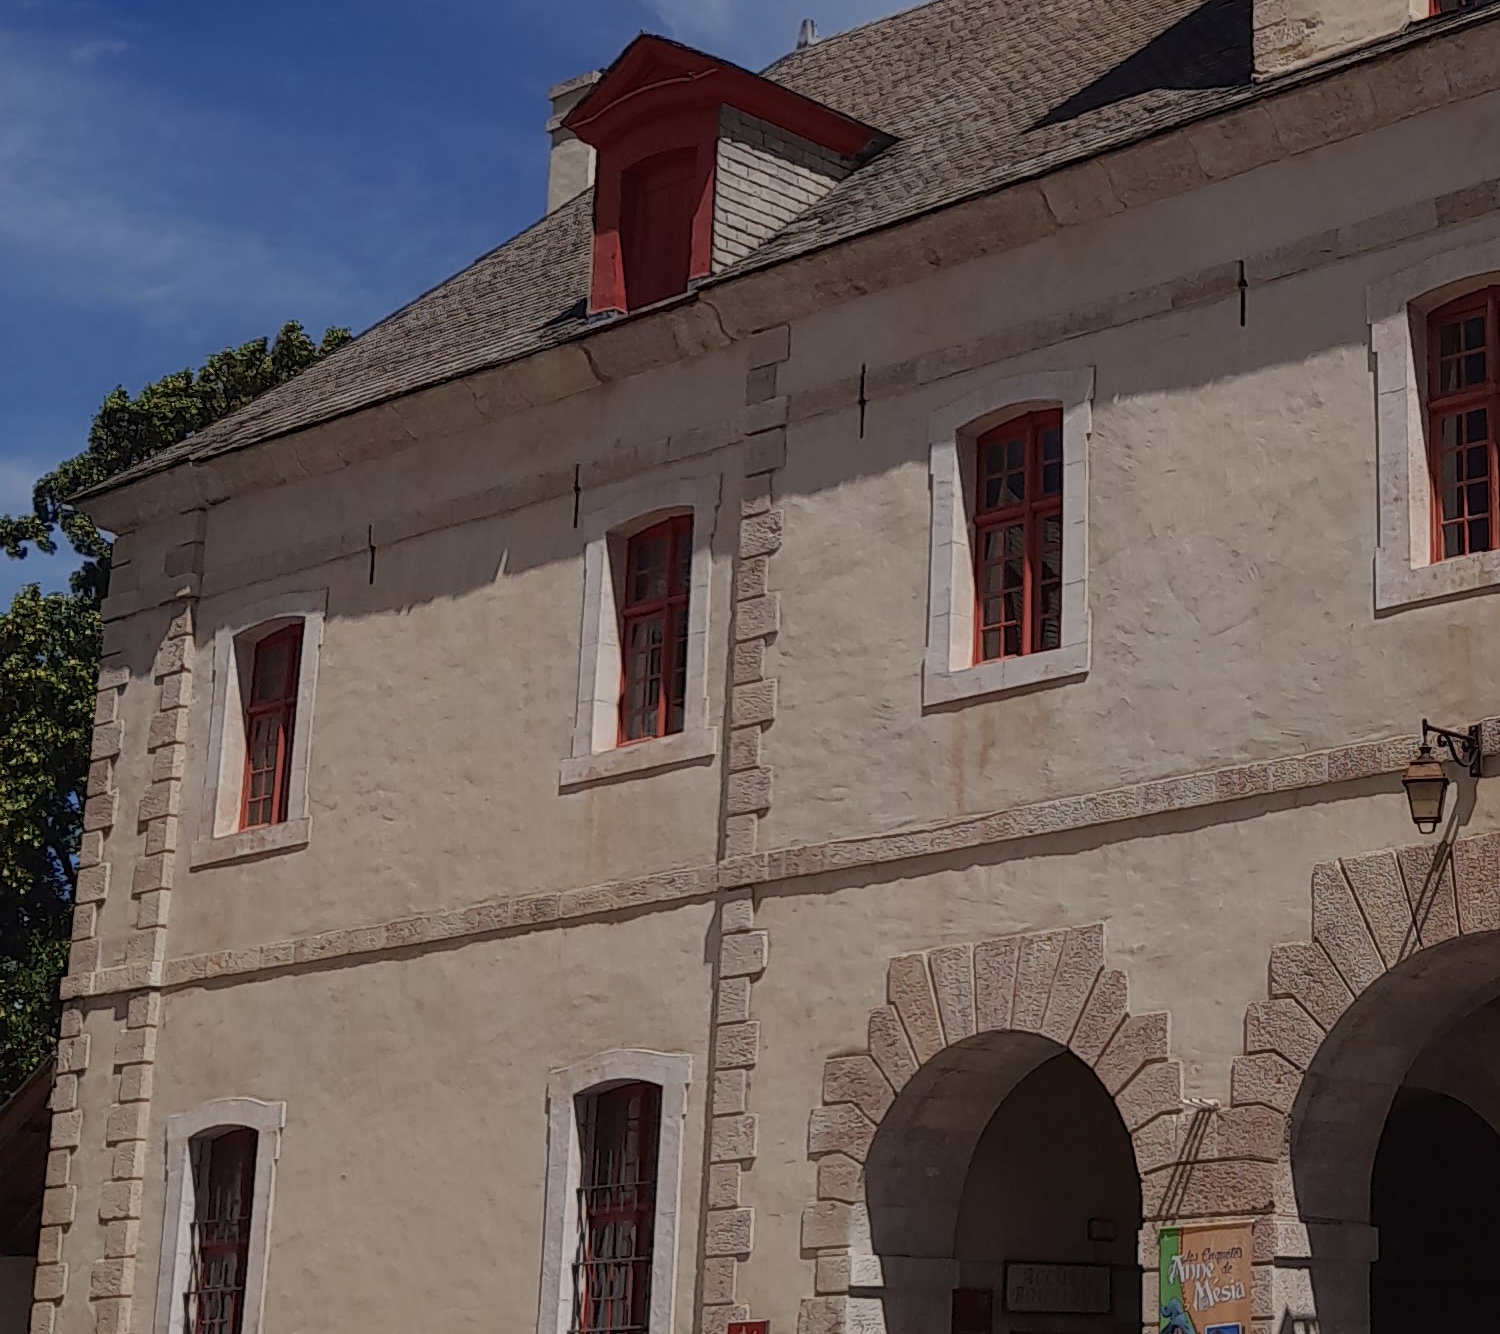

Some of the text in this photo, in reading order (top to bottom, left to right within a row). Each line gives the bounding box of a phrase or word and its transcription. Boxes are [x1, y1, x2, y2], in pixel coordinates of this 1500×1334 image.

[1168, 1255, 1233, 1284] Anne de
[1192, 1277, 1246, 1311] Mésia
